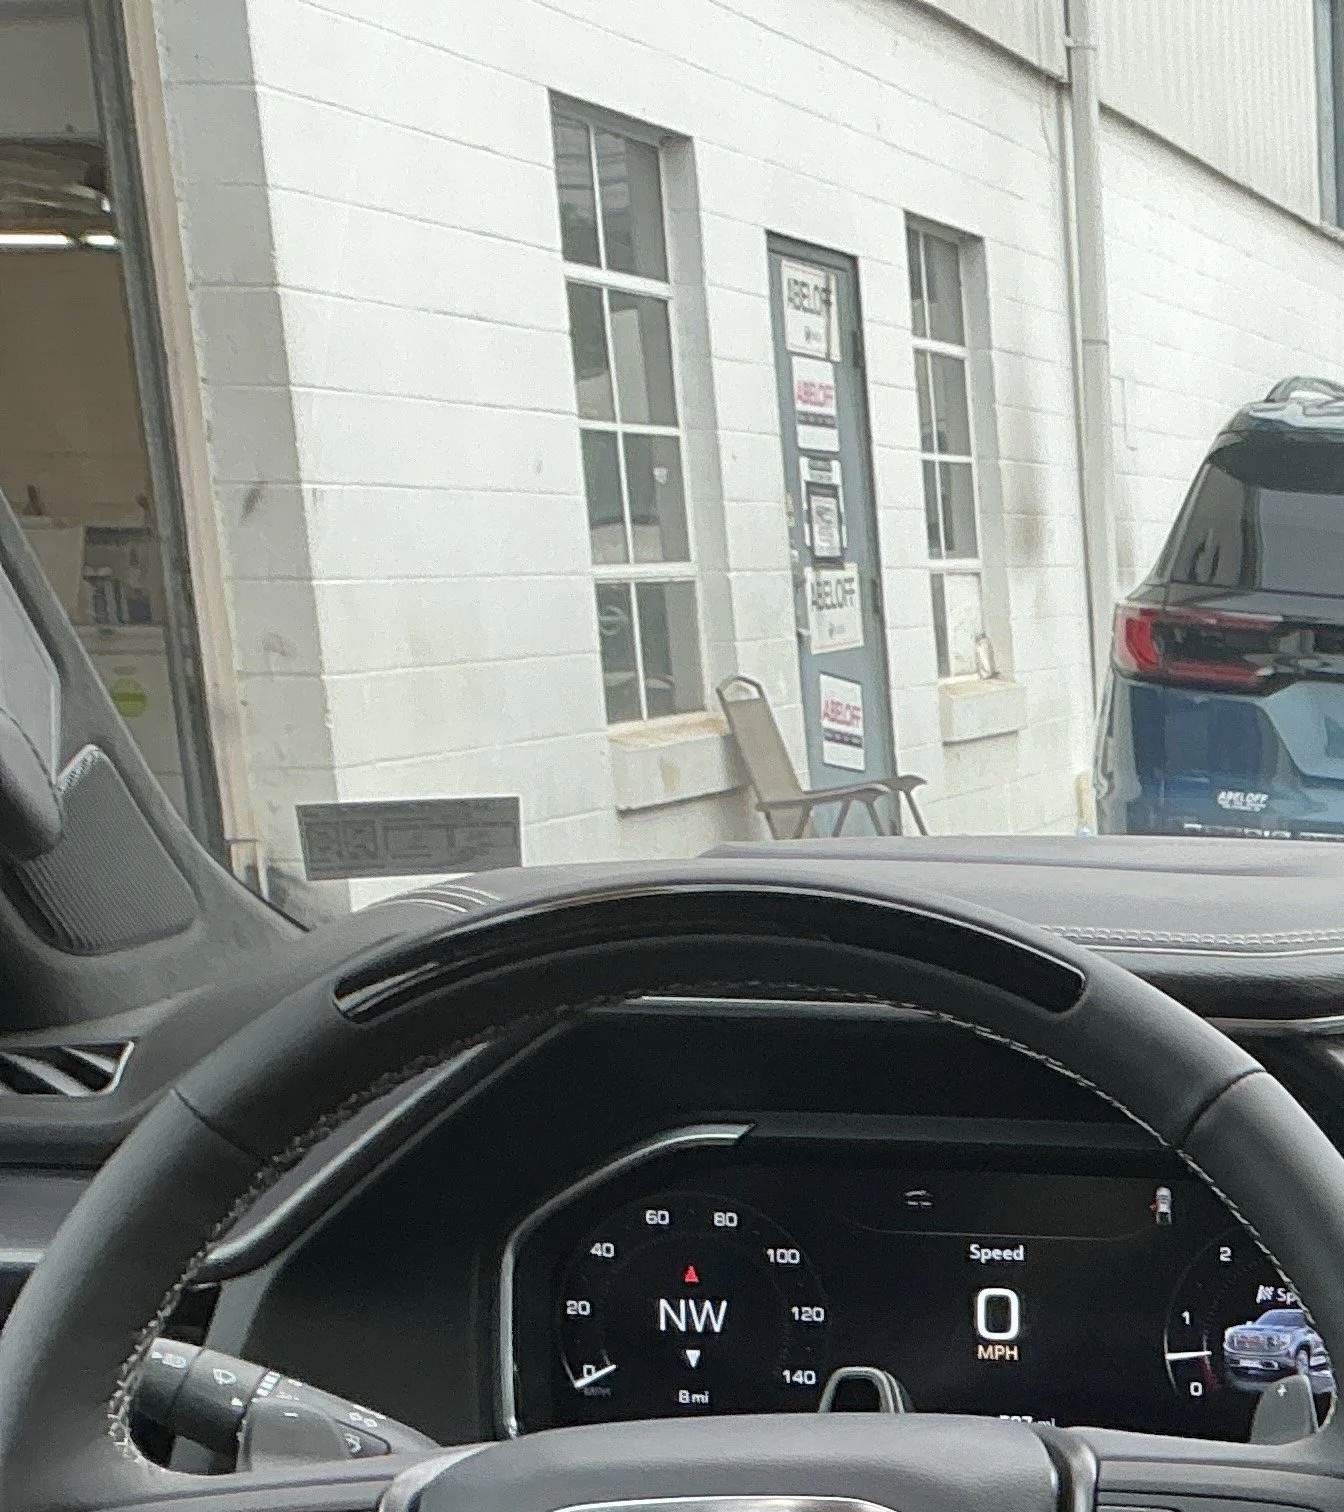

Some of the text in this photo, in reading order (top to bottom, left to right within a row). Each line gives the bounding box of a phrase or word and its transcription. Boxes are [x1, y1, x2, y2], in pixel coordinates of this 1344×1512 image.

[811, 576, 858, 611] ABELOFF
[646, 1210, 670, 1225] 60
[714, 1212, 738, 1227] 80
[590, 1243, 615, 1258] 40
[766, 1248, 800, 1264] 100
[969, 1243, 1025, 1264] Speed
[1219, 1246, 1232, 1262] 2
[566, 1300, 591, 1315] 20
[659, 1298, 728, 1333] NW
[791, 1306, 825, 1322] 120
[977, 1287, 1019, 1340] 0
[1181, 1310, 1191, 1325] 1
[977, 1345, 1018, 1361] MPH
[782, 1369, 816, 1385] 140
[678, 1389, 709, 1404] 8 mi
[1189, 1381, 1203, 1396] 0
